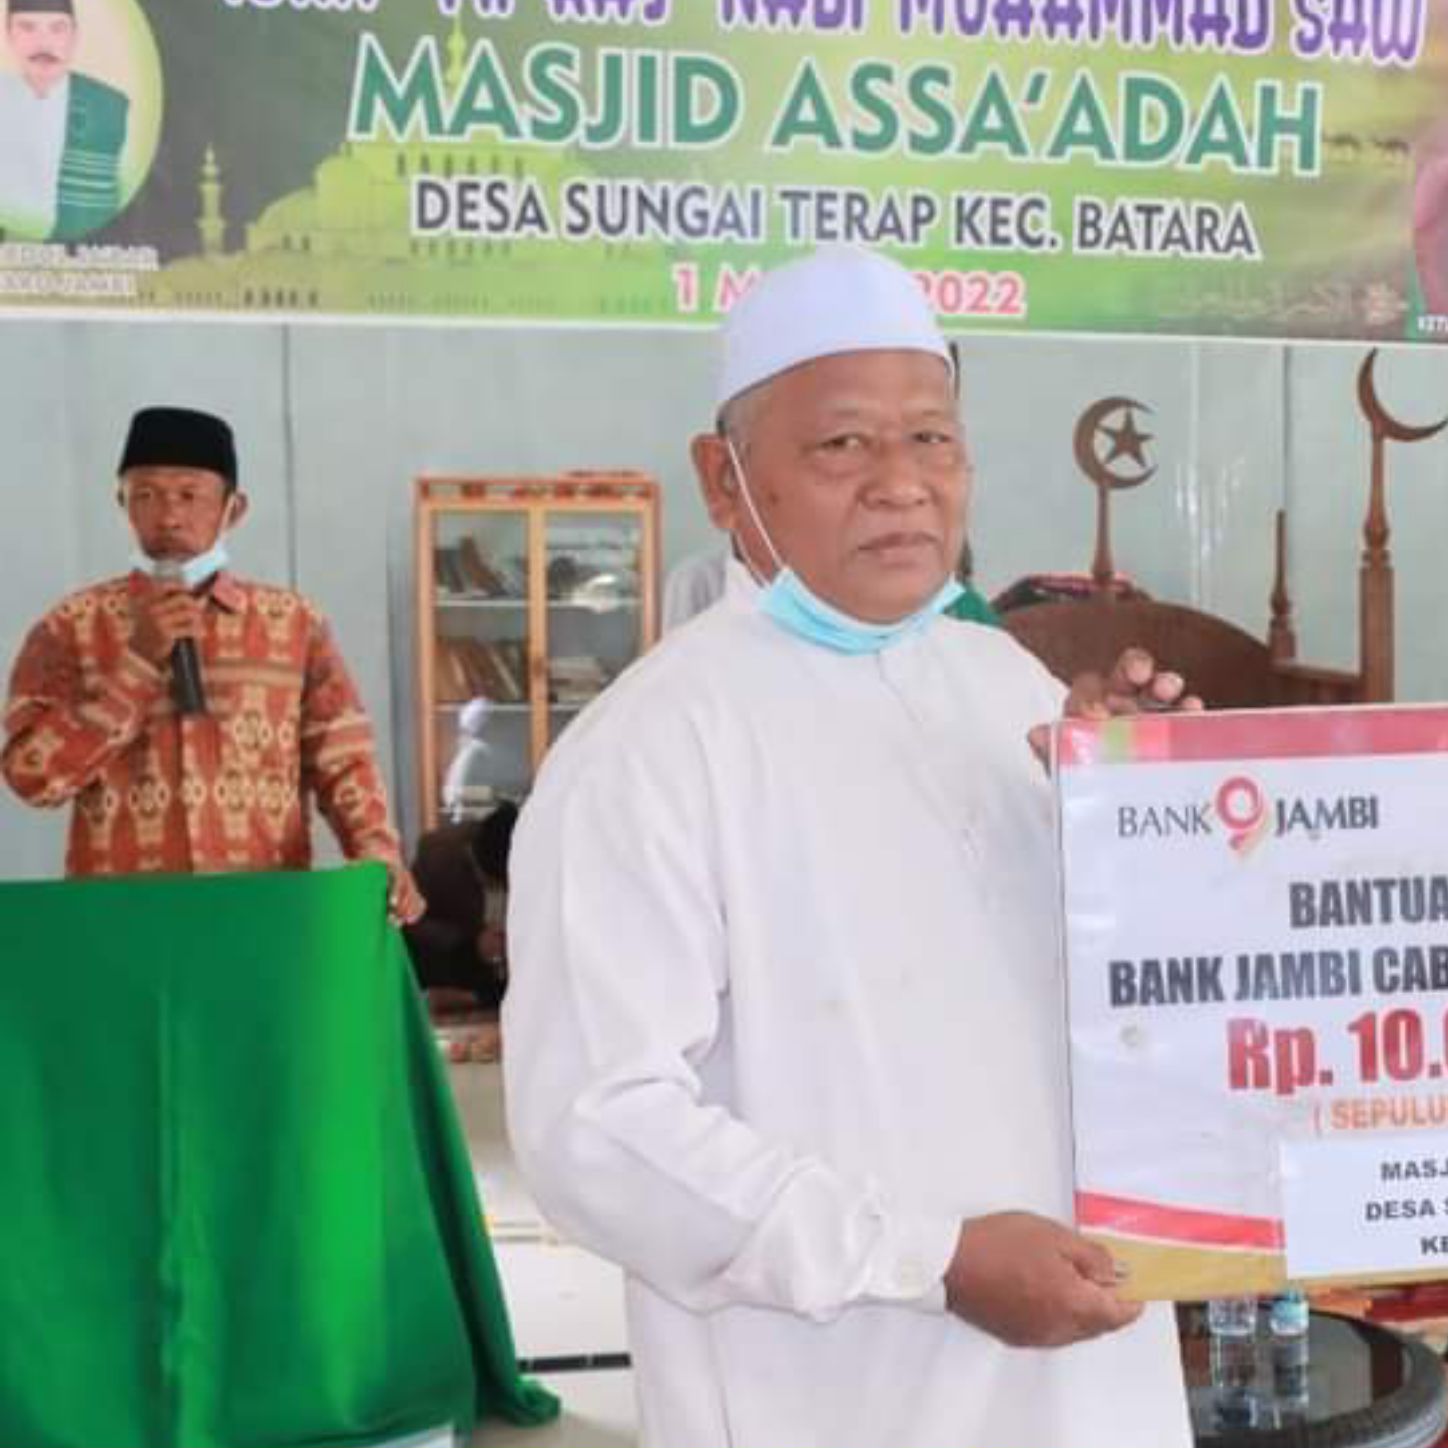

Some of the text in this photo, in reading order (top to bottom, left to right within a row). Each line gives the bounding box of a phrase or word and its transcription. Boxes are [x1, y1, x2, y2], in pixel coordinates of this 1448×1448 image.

[353, 38, 1320, 173] MASJID ASSA'ADAH
[415, 180, 1256, 255] DESA SUNGAI TERAP KEC. BATARA
[674, 266, 695, 307] 1
[1117, 803, 1213, 837] BANK
[1275, 795, 1379, 837] JAMBI
[1108, 955, 1225, 1008] BANK
[1234, 949, 1362, 1002] JAMBI
[1227, 1017, 1334, 1095] Rp.
[1365, 1199, 1436, 1222] DESA
